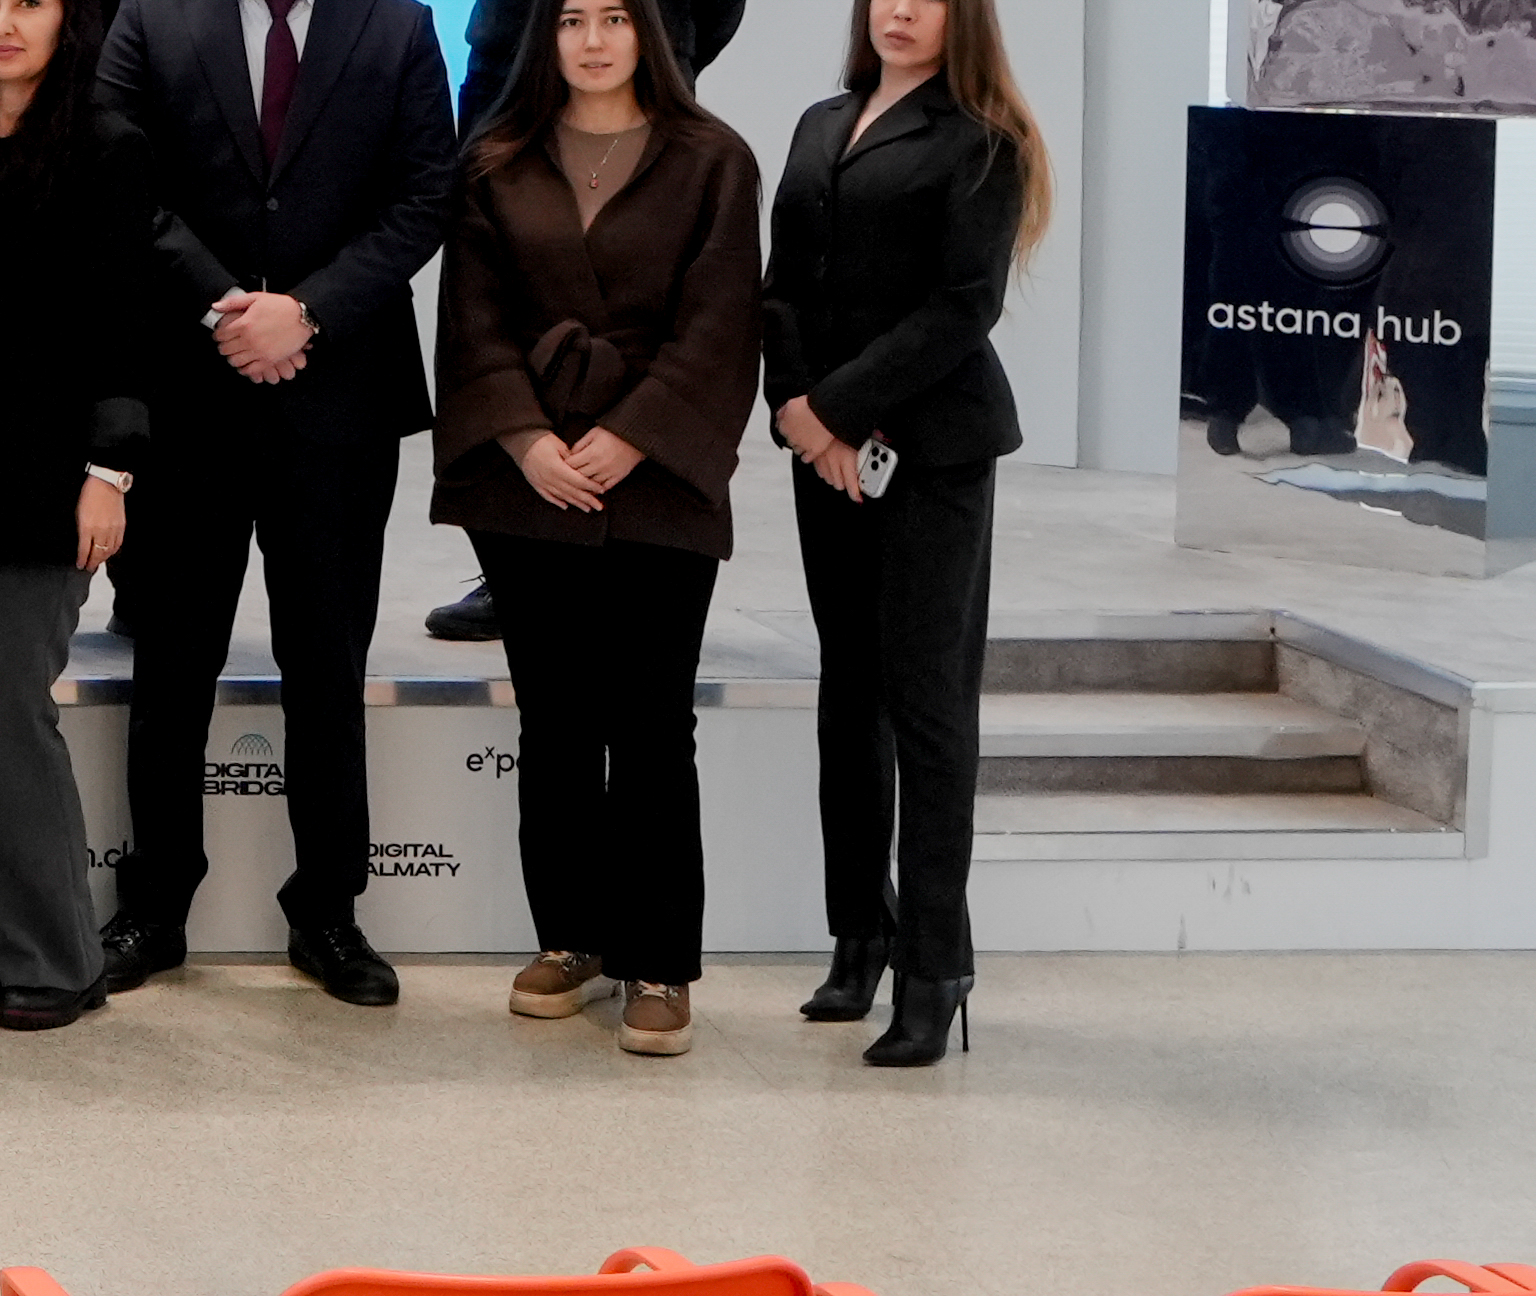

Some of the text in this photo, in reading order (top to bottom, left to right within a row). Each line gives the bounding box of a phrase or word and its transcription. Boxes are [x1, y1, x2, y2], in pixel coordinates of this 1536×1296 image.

[1207, 301, 1462, 346] astana hub
[204, 763, 284, 778] DIGITA
[202, 780, 286, 795] BRIDG
[368, 843, 454, 858] DIGITAL
[366, 862, 461, 877] ALMATY
